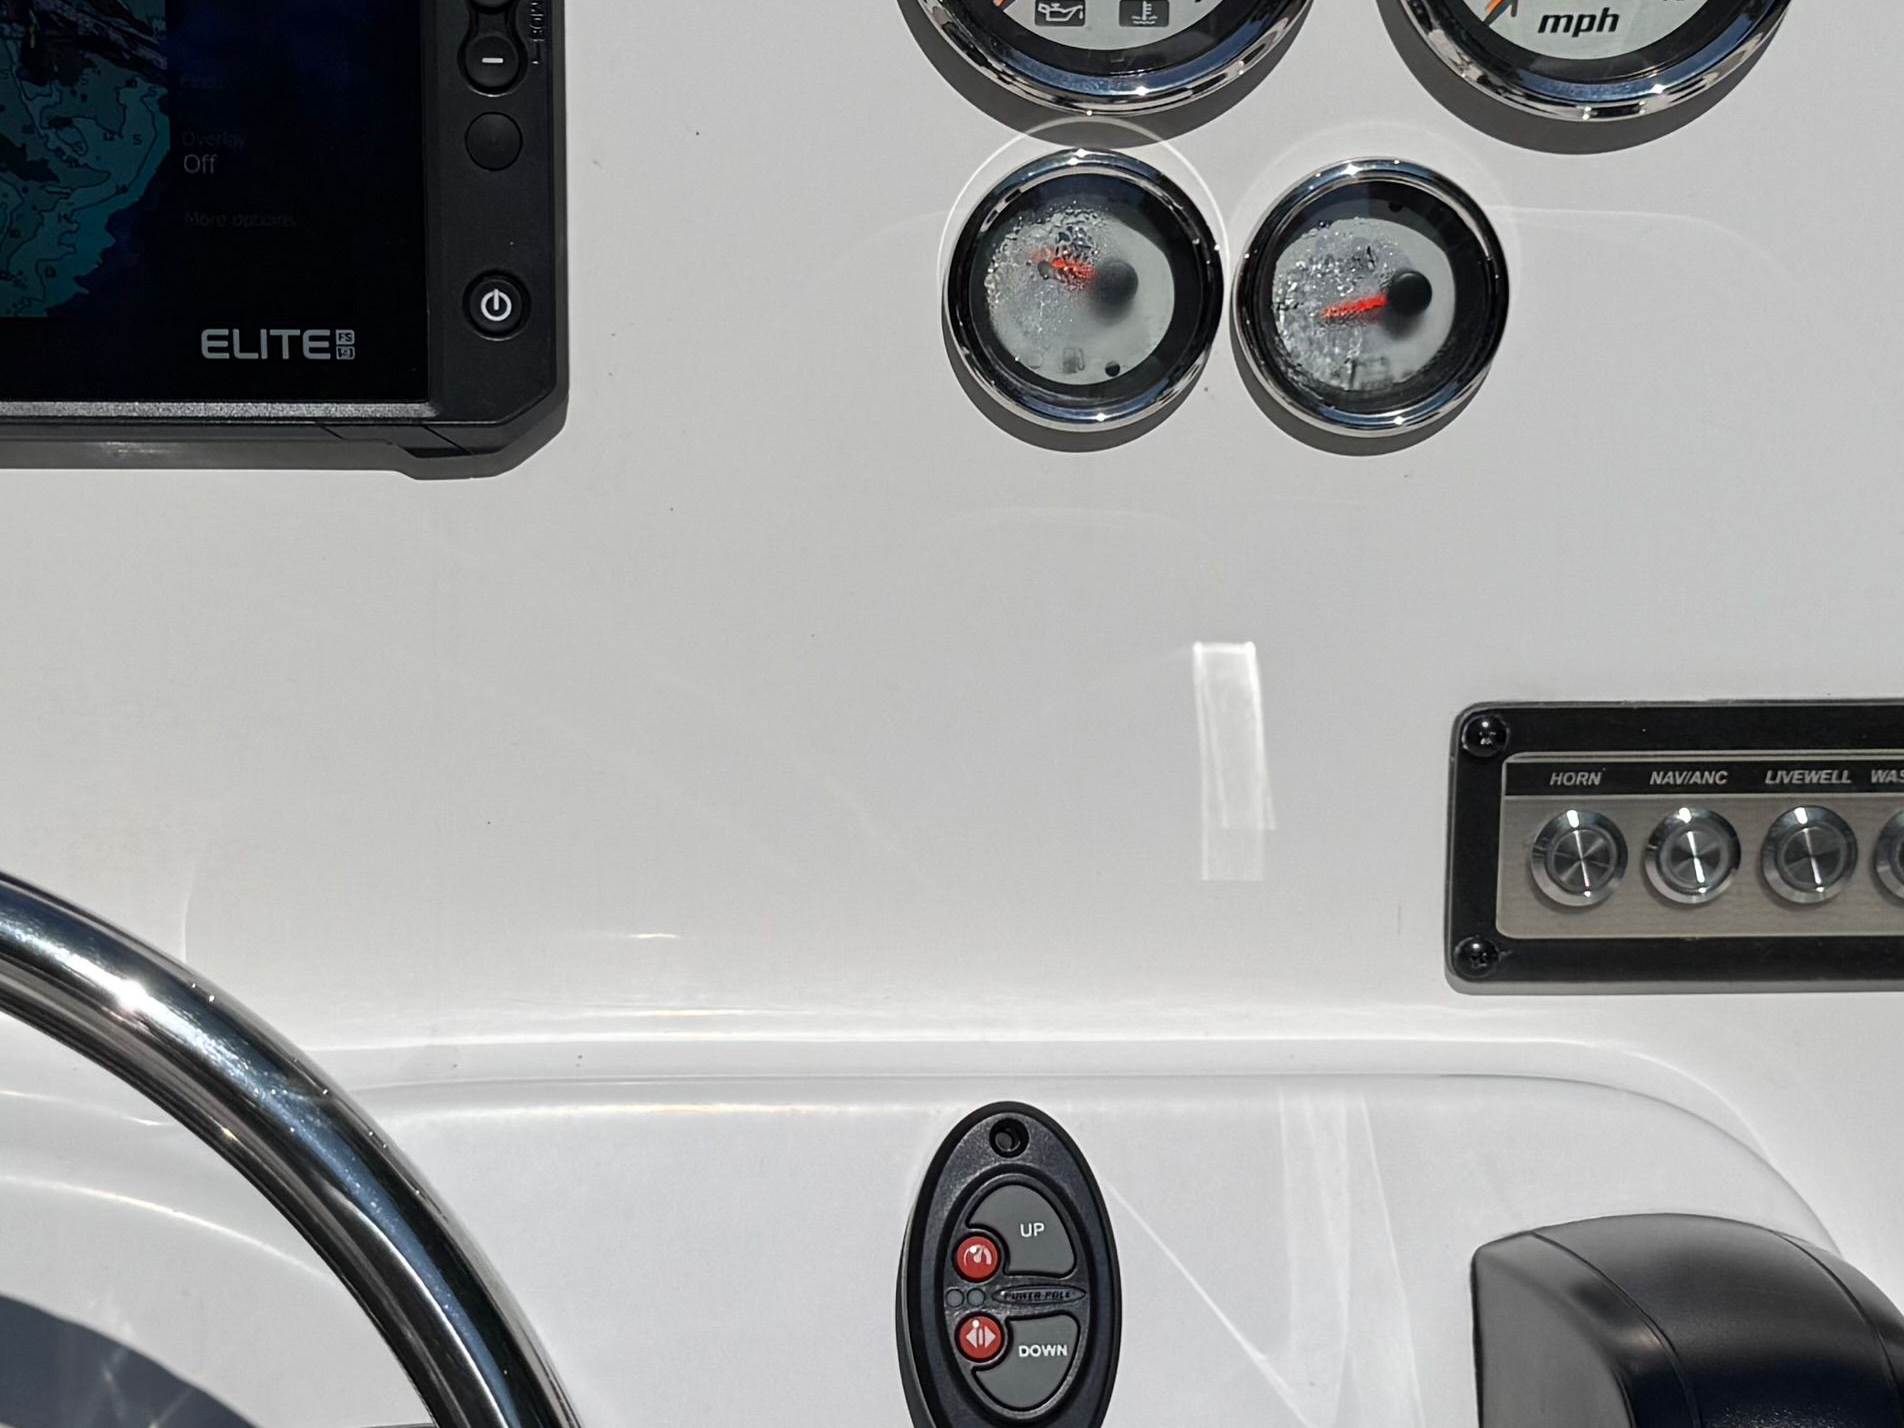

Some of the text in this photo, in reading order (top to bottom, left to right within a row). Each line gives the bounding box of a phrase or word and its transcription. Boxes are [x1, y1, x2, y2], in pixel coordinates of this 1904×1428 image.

[1537, 7, 1621, 39] mph
[183, 153, 218, 175] Off
[200, 328, 332, 360] ELITE
[1549, 771, 1602, 787] HORN
[1649, 770, 1729, 787] NAV/ANC
[1764, 768, 1853, 786] LIVEWELL
[1019, 1222, 1045, 1238] UP
[1017, 1344, 1069, 1359] DOWN
